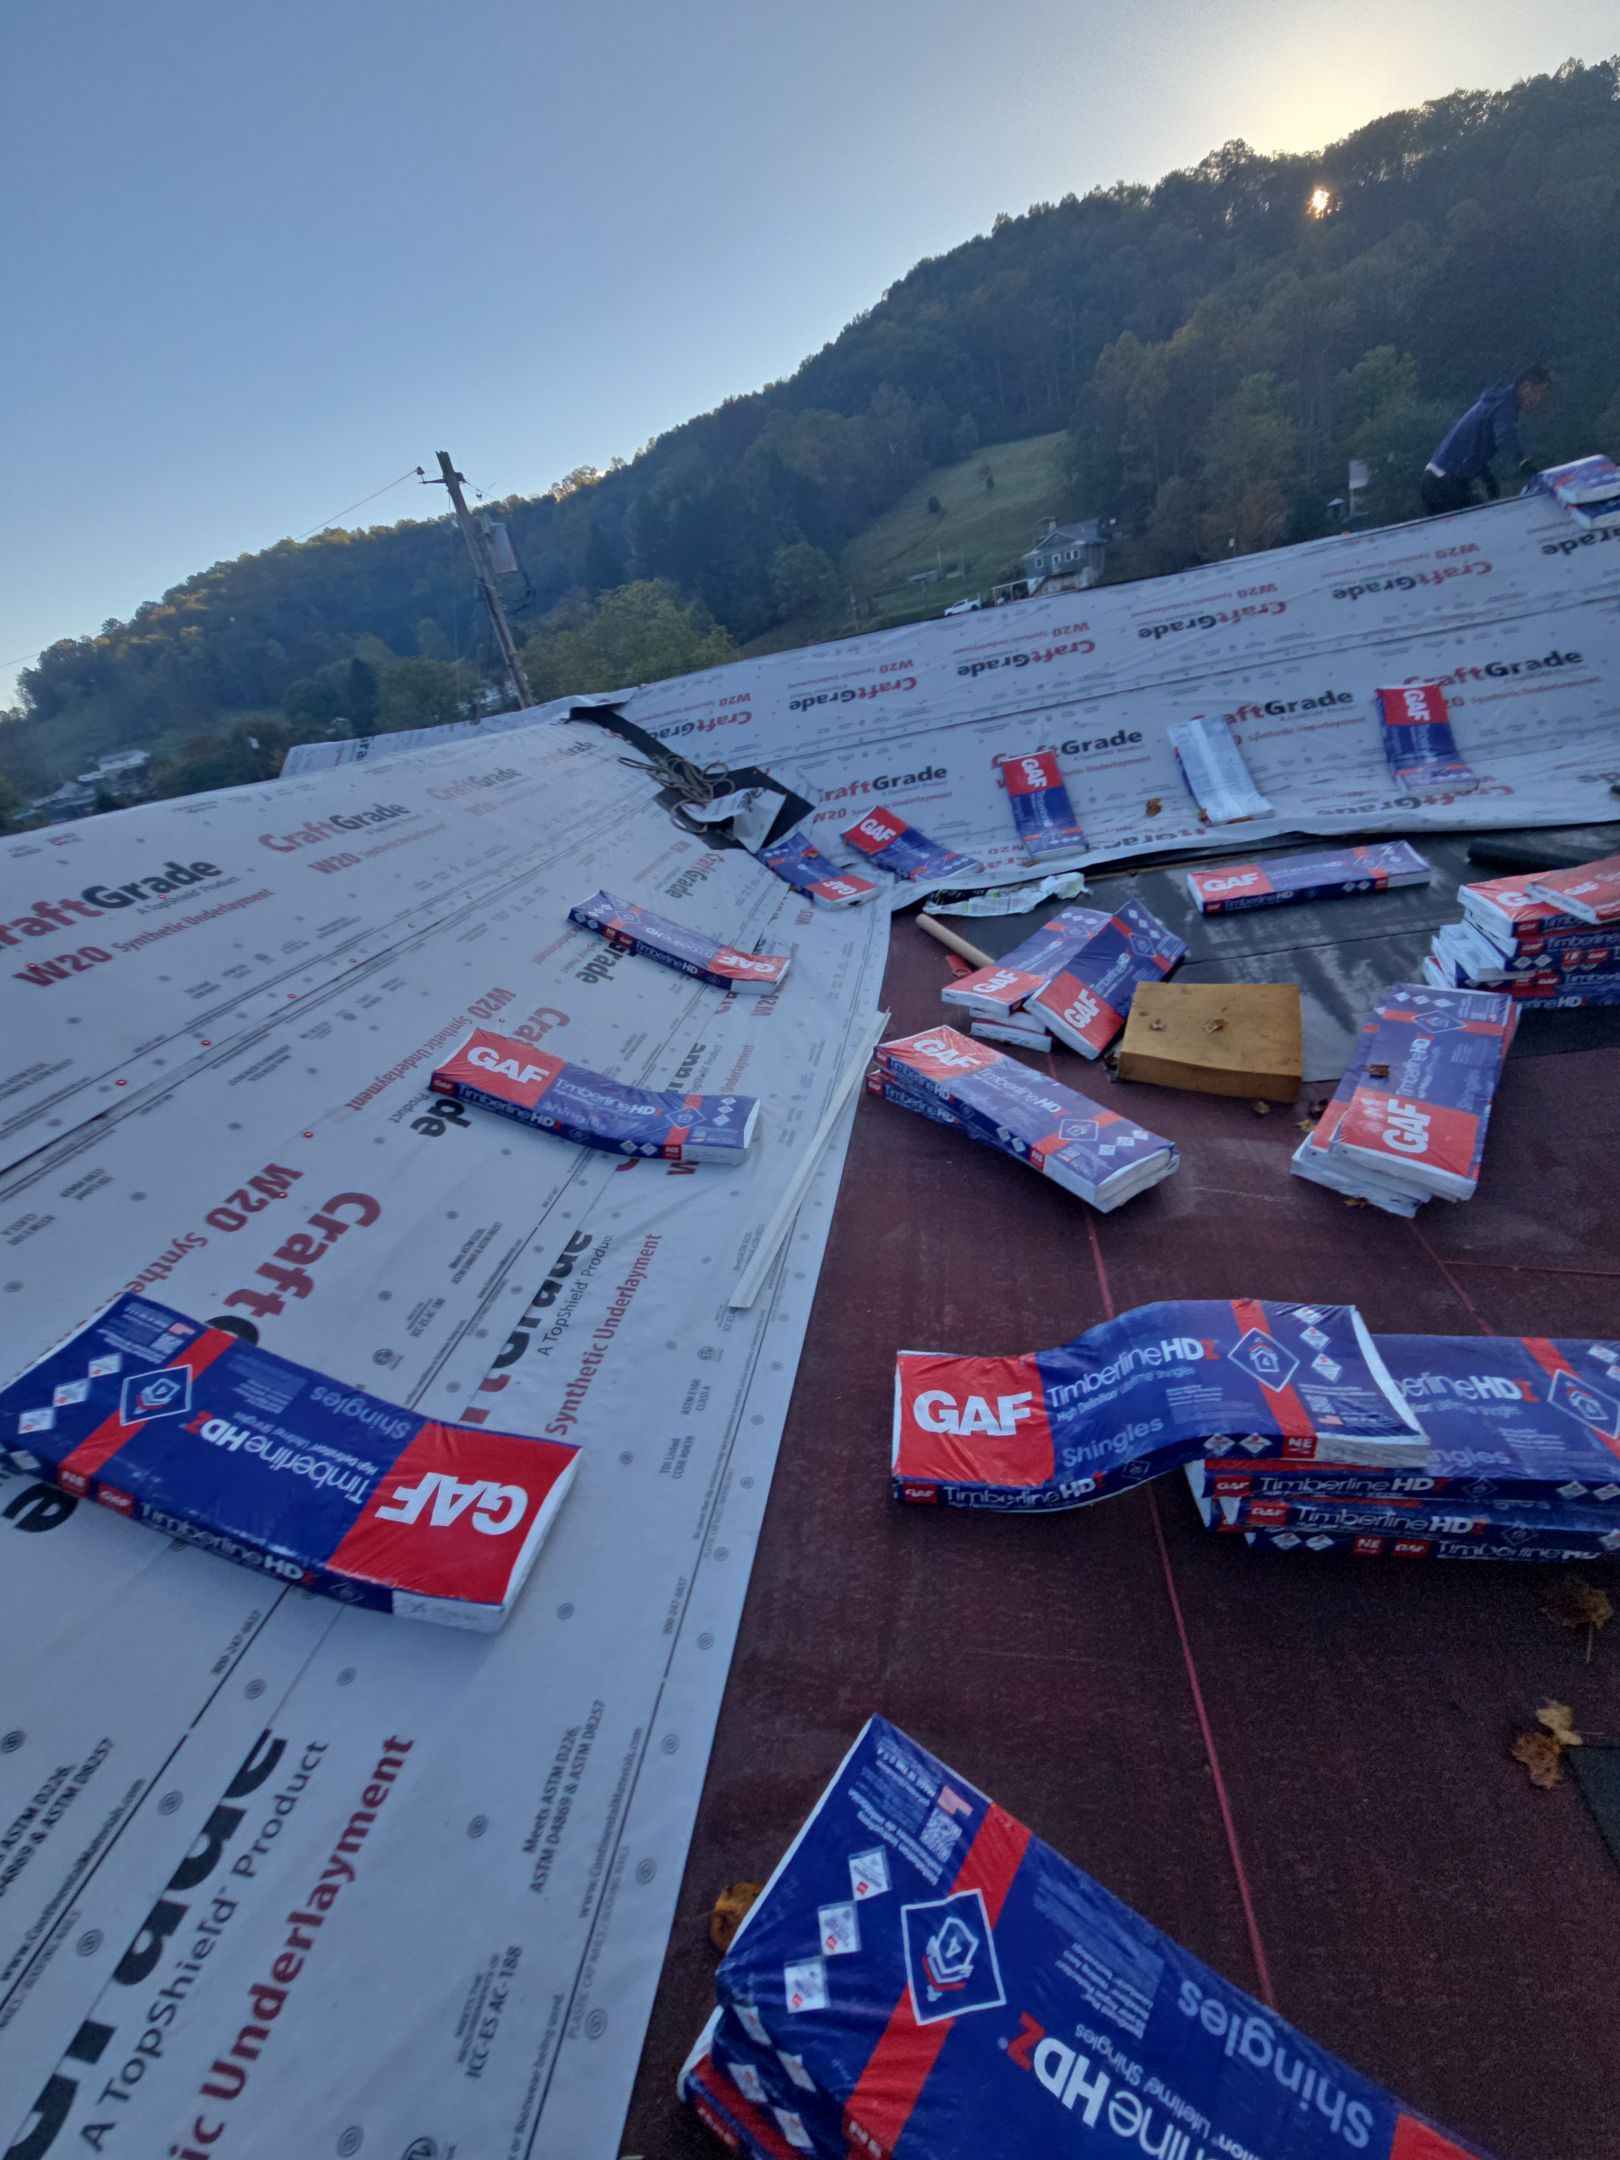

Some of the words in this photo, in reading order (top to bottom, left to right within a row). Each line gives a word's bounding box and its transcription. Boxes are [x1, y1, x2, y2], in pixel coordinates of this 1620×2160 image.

[1238, 582, 1278, 599] W20
[1333, 561, 1493, 601] CraftGrade
[1052, 621, 1090, 637] W20
[1138, 601, 1287, 640] CraftGrade
[879, 659, 914, 674] W20
[957, 640, 1096, 677] CraftGrade
[719, 693, 752, 708] W20
[789, 676, 918, 713] CraftGrade
[1402, 690, 1431, 721] GAF
[650, 711, 753, 740] CraftGra
[425, 767, 523, 800] CraftGrade
[1021, 758, 1047, 787] GAF
[258, 803, 411, 853] CraftGrade
[860, 818, 897, 842] GAF
[307, 852, 362, 874] W20
[666, 851, 726, 900] CraftGrade
[1203, 872, 1261, 892] GAF
[0, 861, 223, 949] raftGrade
[822, 879, 857, 896] GAF
[12, 946, 114, 987] W20
[111, 918, 190, 952] Synthetic
[184, 888, 275, 926] Underlayment
[575, 940, 634, 986] rade
[719, 955, 776, 973] GAF
[972, 969, 1019, 993] GAF
[467, 987, 518, 1020] W20
[1064, 988, 1100, 1030] GAF
[424, 1014, 474, 1054] Synthetic
[467, 1046, 549, 1084] GAF
[913, 1039, 981, 1069] GAF
[345, 1044, 431, 1111] Underlayment
[434, 1080, 454, 1090] GAF
[1382, 1099, 1432, 1154] GAF
[205, 1163, 304, 1232] W20
[580, 1234, 614, 1279] Produc
[543, 1278, 588, 1344] TopShield
[537, 1343, 550, 1357] A
[545, 1342, 609, 1436] Synthetic
[596, 1233, 664, 1342] Underlayment
[309, 1386, 412, 1440] Shingles
[679, 1395, 695, 1416] ASTM
[695, 1391, 711, 1412] CLASS
[913, 1389, 1033, 1436] GAF
[1056, 1409, 1078, 1423] High
[1062, 1417, 1165, 1468] Shingles
[356, 1457, 378, 1476] High
[1216, 1481, 1250, 1491] GAF
[374, 1472, 529, 1536] GAF
[904, 1488, 935, 1499] GAF
[1252, 1506, 1287, 1517] GAF
[582, 1699, 607, 1742] D8257
[569, 1741, 593, 1781] ASTM
[28, 1826, 49, 1847] &
[40, 1781, 81, 1832] ASTM
[72, 1733, 116, 1789] D8257
[563, 1780, 579, 1795] &
[0, 1802, 40, 1852] ASTM
[231, 1741, 330, 1879] Product
[522, 1806, 551, 1856] Meets
[541, 1764, 565, 1806] ASTM
[545, 1795, 574, 1847] D4869
[528, 1847, 556, 1895] ASTM
[201, 1734, 416, 2101] Underlayment
[97, 1896, 240, 2106] TopShield
[464, 2016, 501, 2079] ICC-ES
[486, 1944, 524, 2013] AC-188
[1074, 2023, 1144, 2088] Shingles
[1177, 1980, 1374, 2149] Shingles
[80, 2122, 115, 2153] A
